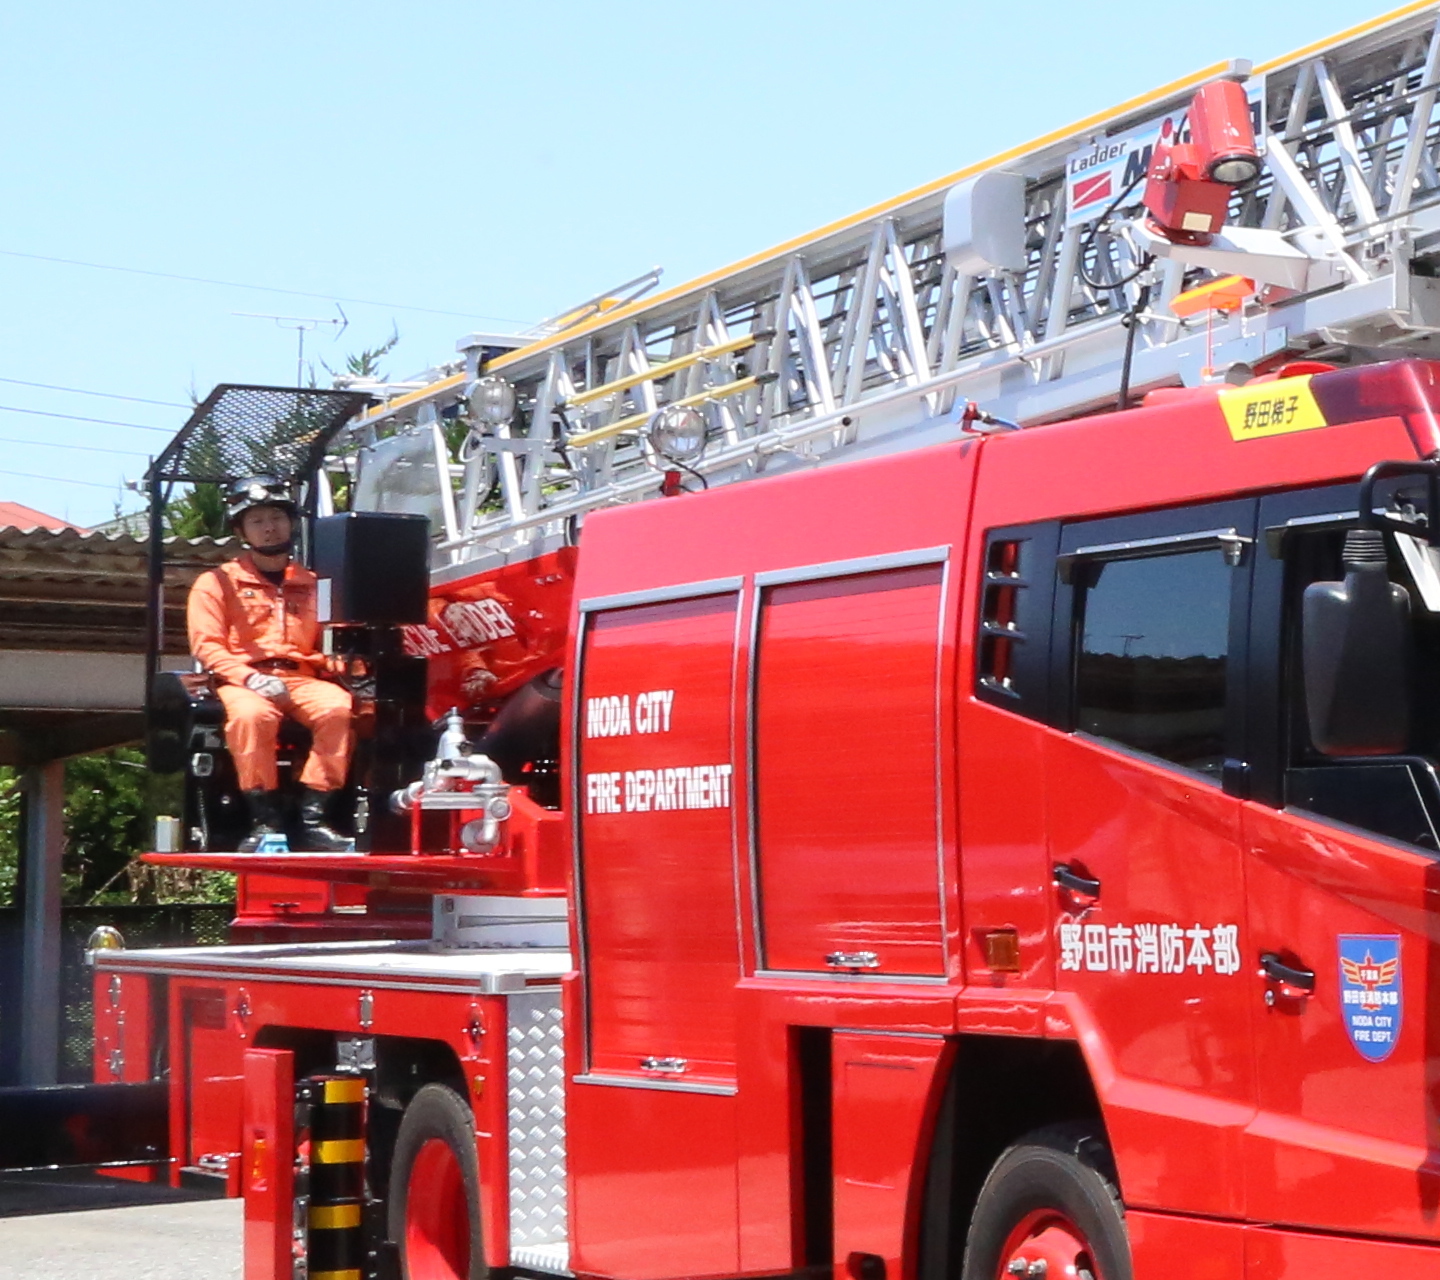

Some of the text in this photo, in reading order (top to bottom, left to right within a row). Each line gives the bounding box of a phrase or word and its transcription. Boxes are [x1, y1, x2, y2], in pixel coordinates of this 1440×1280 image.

[1070, 141, 1127, 174] Ladder
[1243, 396, 1298, 430] 野田梯子
[587, 689, 675, 739] NODA CITY
[587, 764, 732, 815] FIRE DEPARTMENT
[1060, 922, 1241, 976] 野田市消防本部
[1342, 989, 1398, 1005] 野田市消防本部
[1351, 1015, 1393, 1028] NODA CITY
[1354, 1030, 1371, 1042] FIRE
